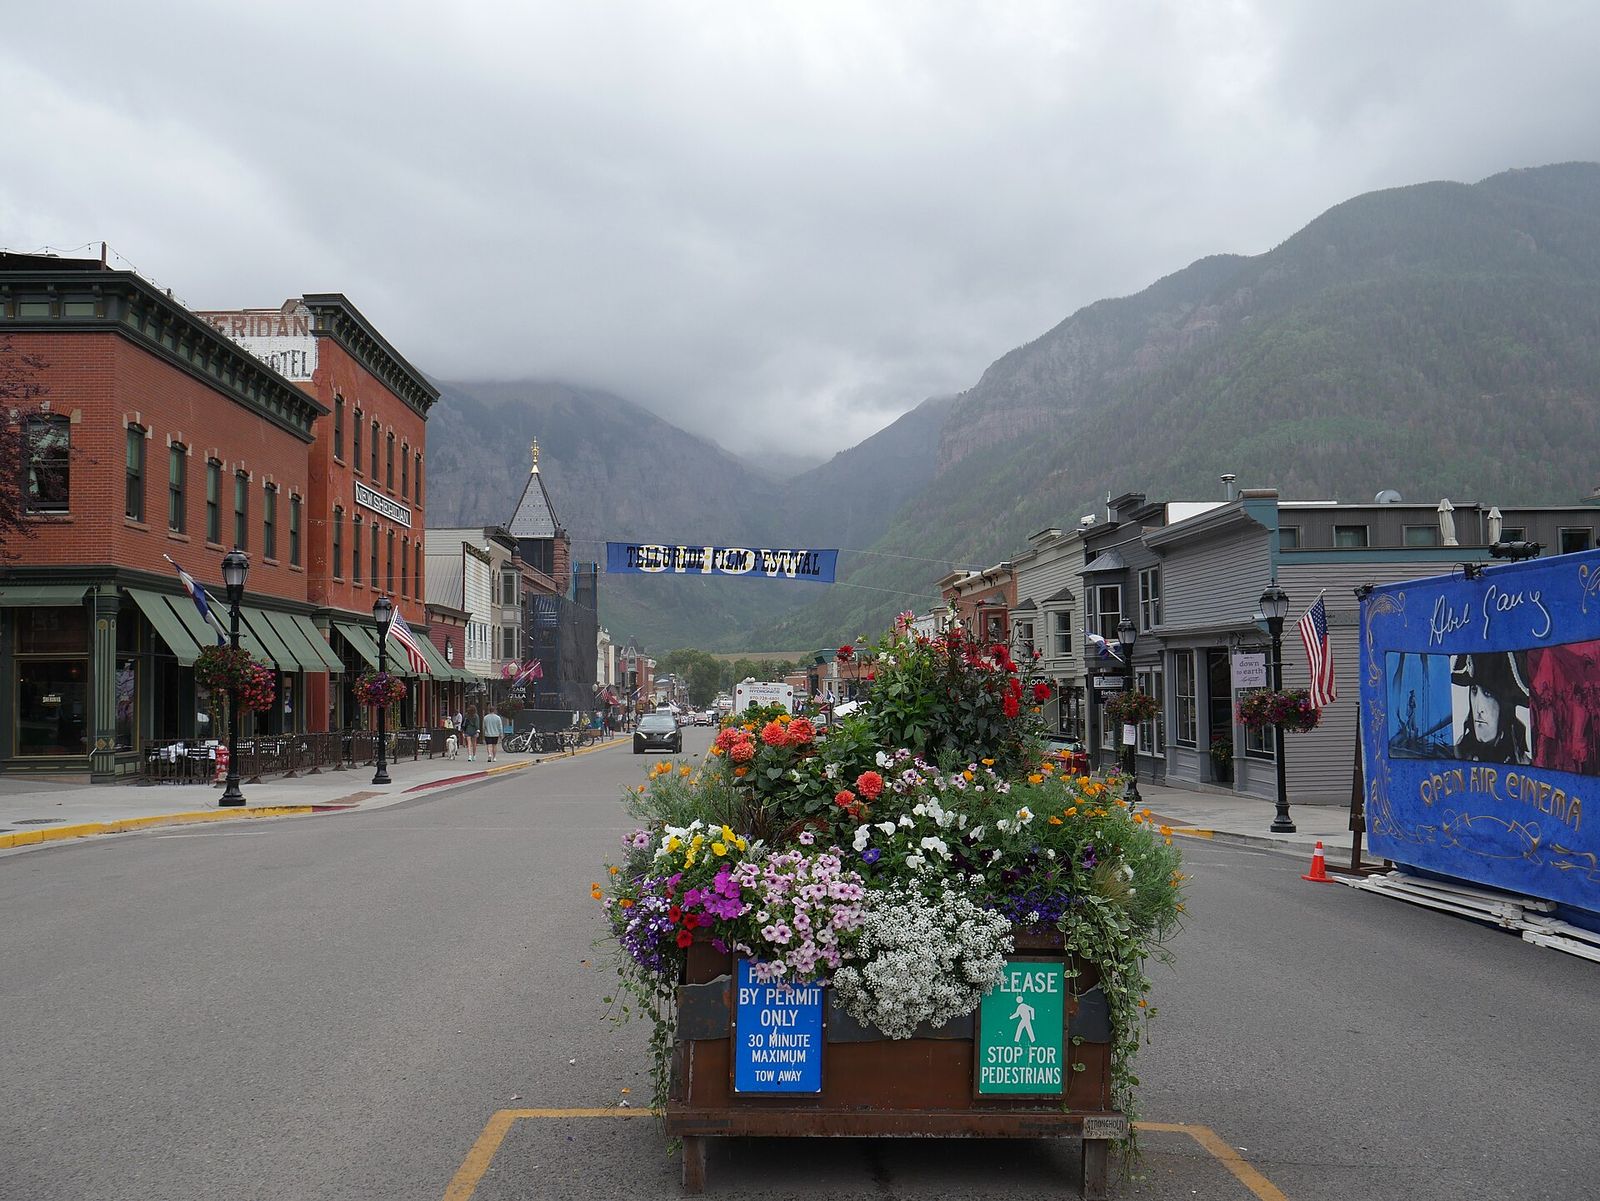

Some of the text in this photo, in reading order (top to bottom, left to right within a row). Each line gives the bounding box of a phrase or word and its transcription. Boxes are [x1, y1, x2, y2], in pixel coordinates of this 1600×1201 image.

[206, 315, 309, 337] ERIDAN
[356, 483, 409, 524] NEW SHERIDAN
[627, 546, 820, 576] TELLURIDE FILM FESTIVAL
[1429, 594, 1470, 646] Abel
[1420, 767, 1582, 832] OPEN AIR CINEMA
[1000, 972, 1058, 993] LEASE
[740, 988, 820, 1005] BY PERMIT
[761, 1009, 798, 1027] ONLY
[748, 1034, 810, 1047] 30 MINUTE
[752, 1050, 806, 1063] MAXIMUM
[987, 1046, 1056, 1064] STOP FOR
[755, 1071, 802, 1082] TOW AWAY
[981, 1067, 1061, 1084] PEDESTRIANS
